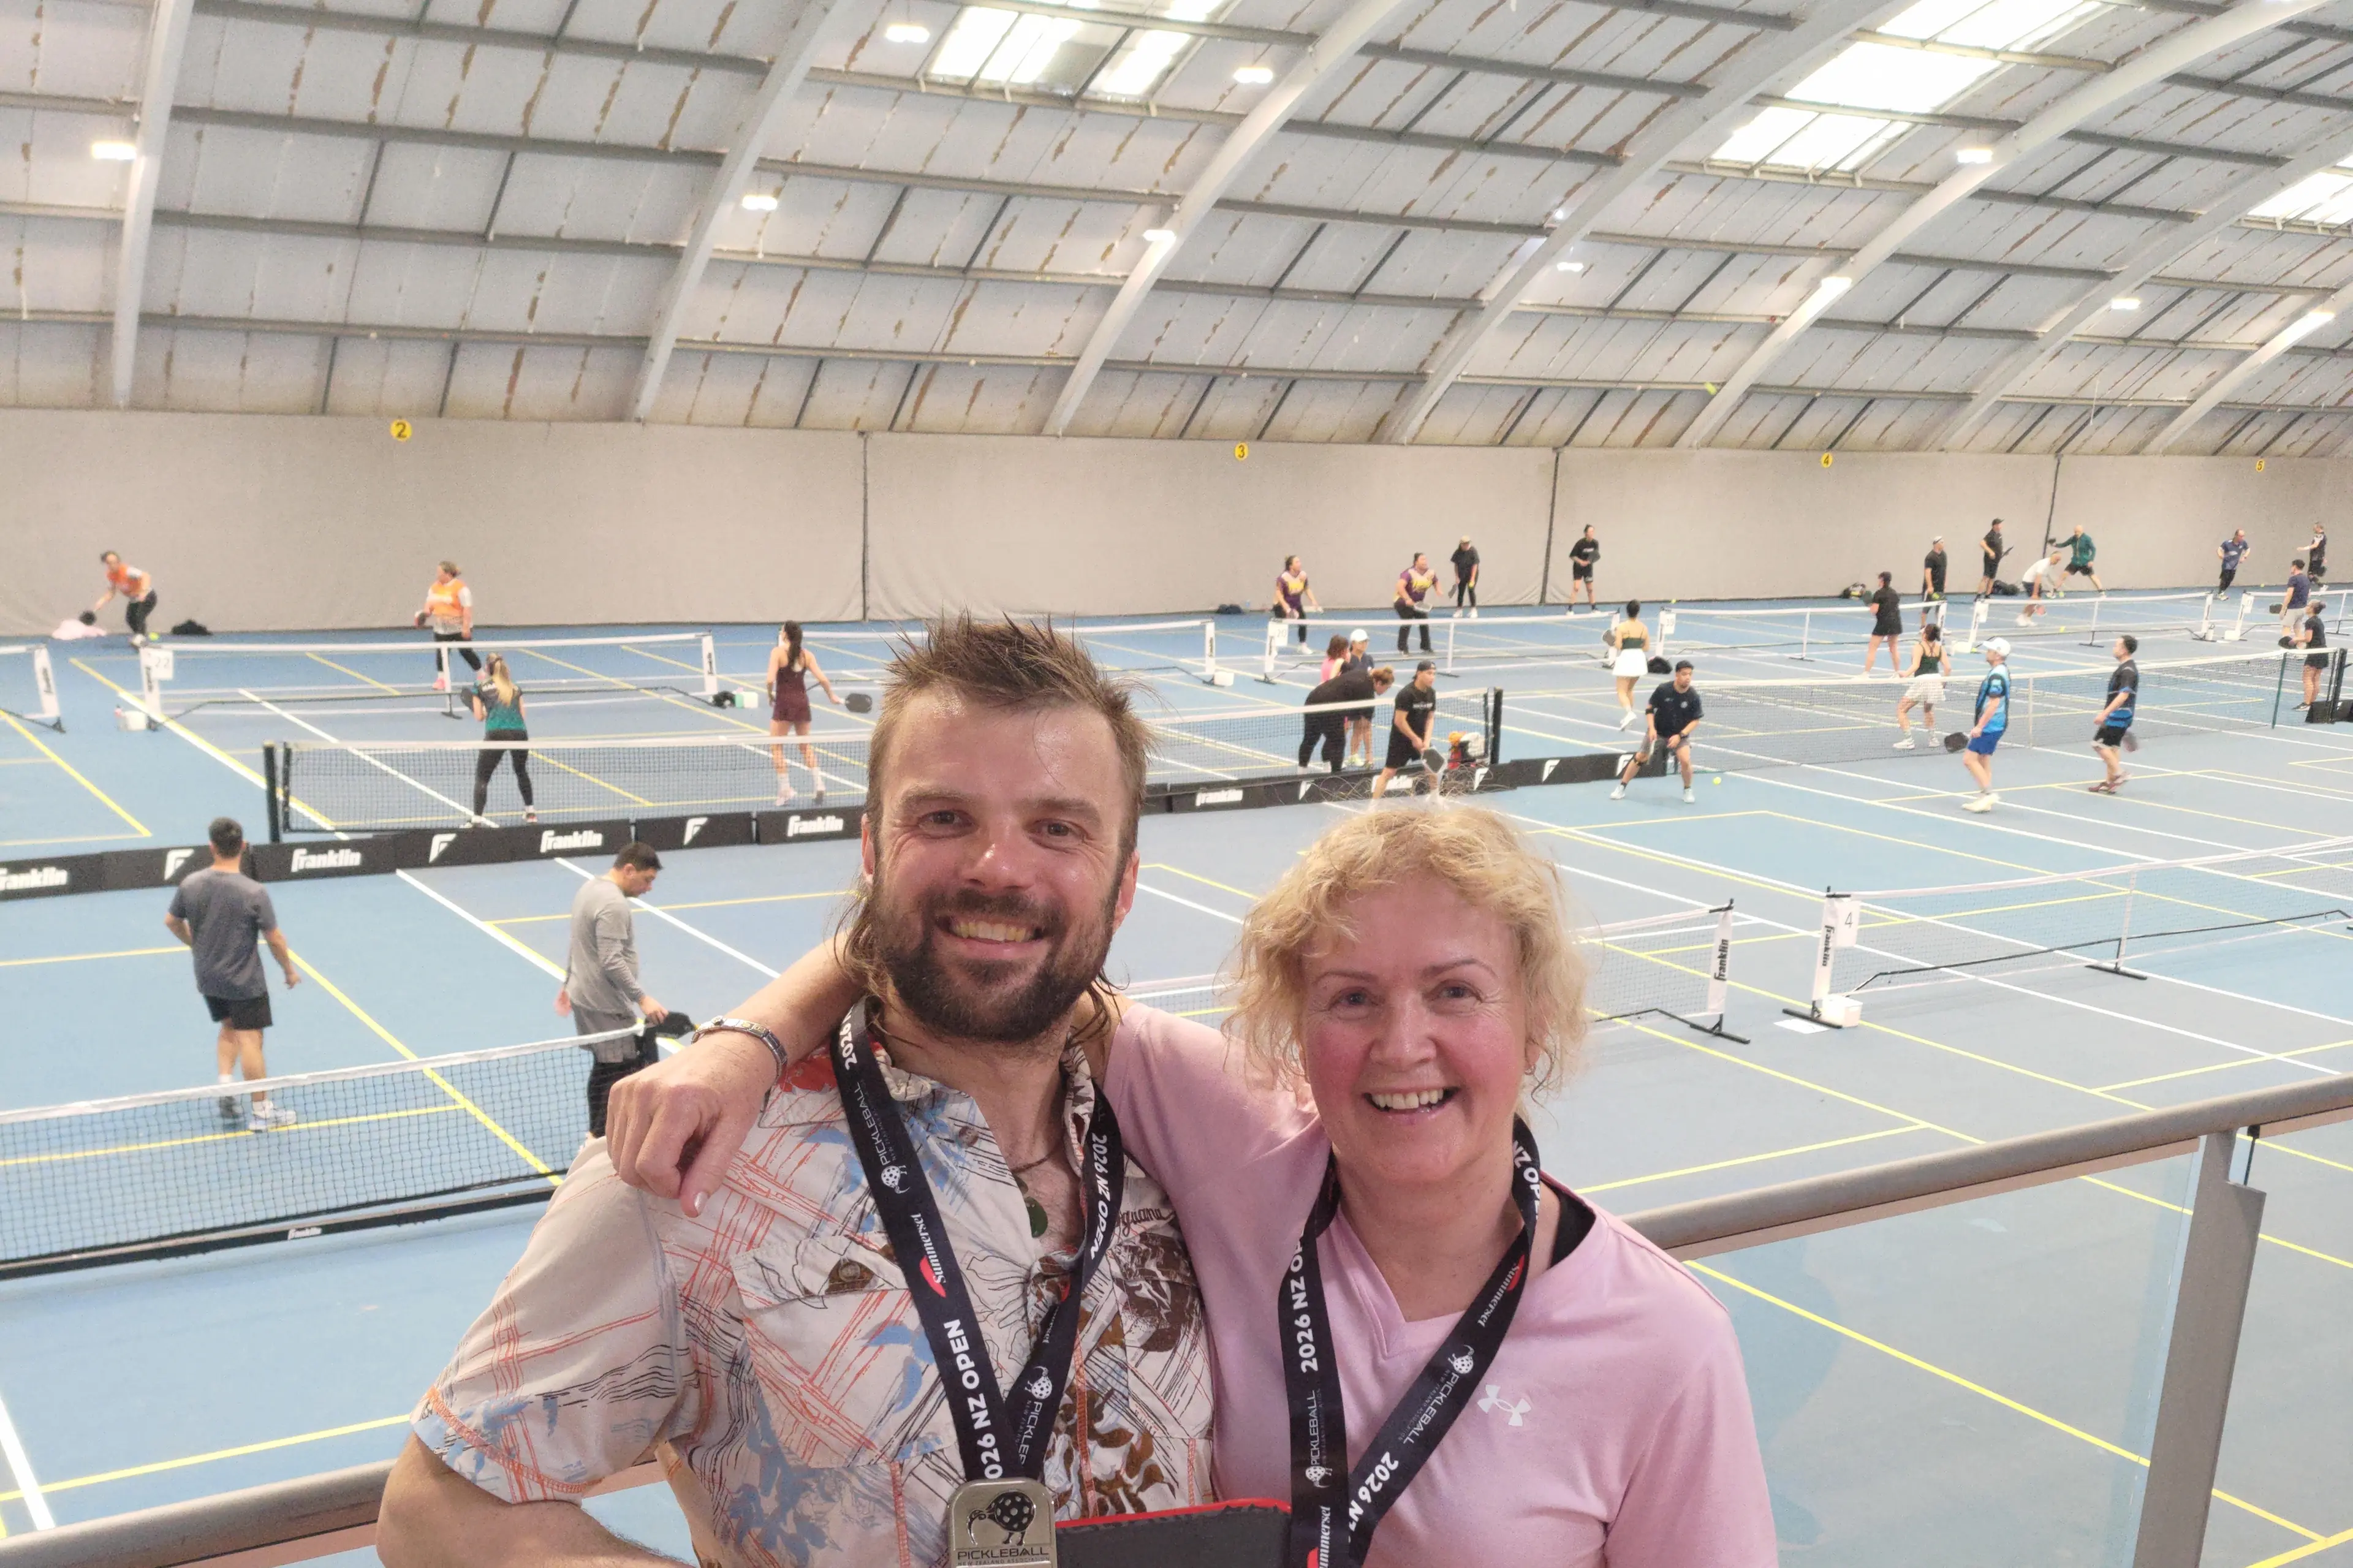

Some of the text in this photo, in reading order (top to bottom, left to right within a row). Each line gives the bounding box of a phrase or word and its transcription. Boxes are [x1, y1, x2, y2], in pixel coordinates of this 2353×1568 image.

[395, 421, 407, 439] 2
[1237, 444, 1245, 459] 3
[1824, 453, 1830, 465] 4
[2257, 460, 2264, 471] 5
[154, 657, 170, 669] 22
[540, 829, 603, 854] Franklin
[787, 815, 844, 837] Franklin
[290, 848, 362, 873] Franklin
[1844, 912, 1853, 928] 4
[839, 1023, 858, 1071] 2026
[854, 1081, 890, 1166] PICKLEBALL
[1091, 1132, 1108, 1174] 2026
[1095, 1173, 1111, 1202] NZ
[910, 1213, 947, 1284] Summerset
[1090, 1200, 1108, 1260] OPEN
[1290, 1275, 1309, 1311] NZ
[1477, 1263, 1520, 1328] Summerset
[1294, 1313, 1318, 1374] 2026
[943, 1319, 1003, 1480] 026 NZ OPEN
[1403, 1372, 1460, 1444] PICKLEBALL
[1306, 1389, 1320, 1466] PICKLEBALL
[1358, 1451, 1399, 1504] 2026
[957, 1547, 1050, 1560] PICKLEBALL
[1319, 1505, 1331, 1568] ummerset
